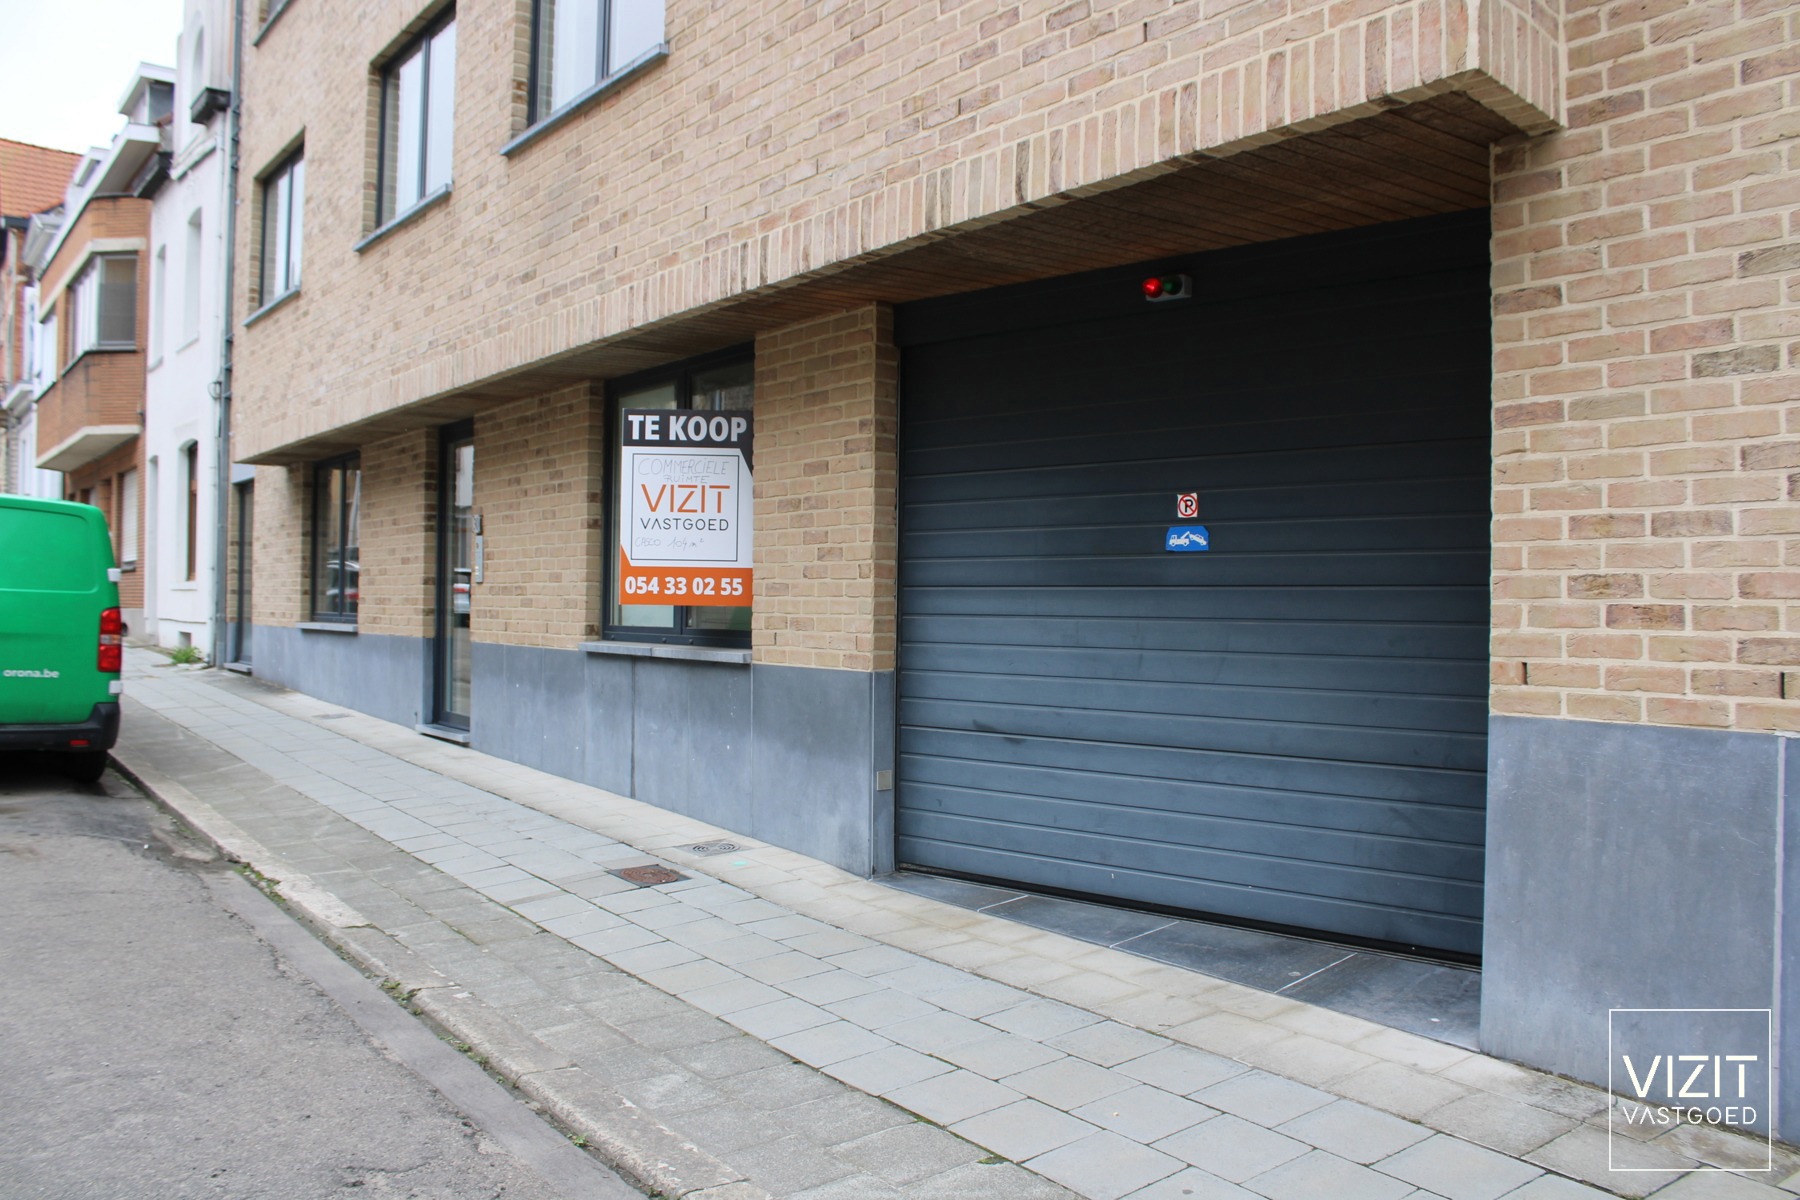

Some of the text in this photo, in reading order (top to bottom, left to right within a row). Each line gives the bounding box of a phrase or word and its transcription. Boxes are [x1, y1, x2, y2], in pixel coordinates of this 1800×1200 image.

[628, 414, 747, 442] TE KOOP
[641, 484, 731, 514] VIZIT
[640, 517, 729, 532] VASTGOED
[625, 576, 743, 596] 054 33 02 55
[3, 668, 60, 679] orona.be
